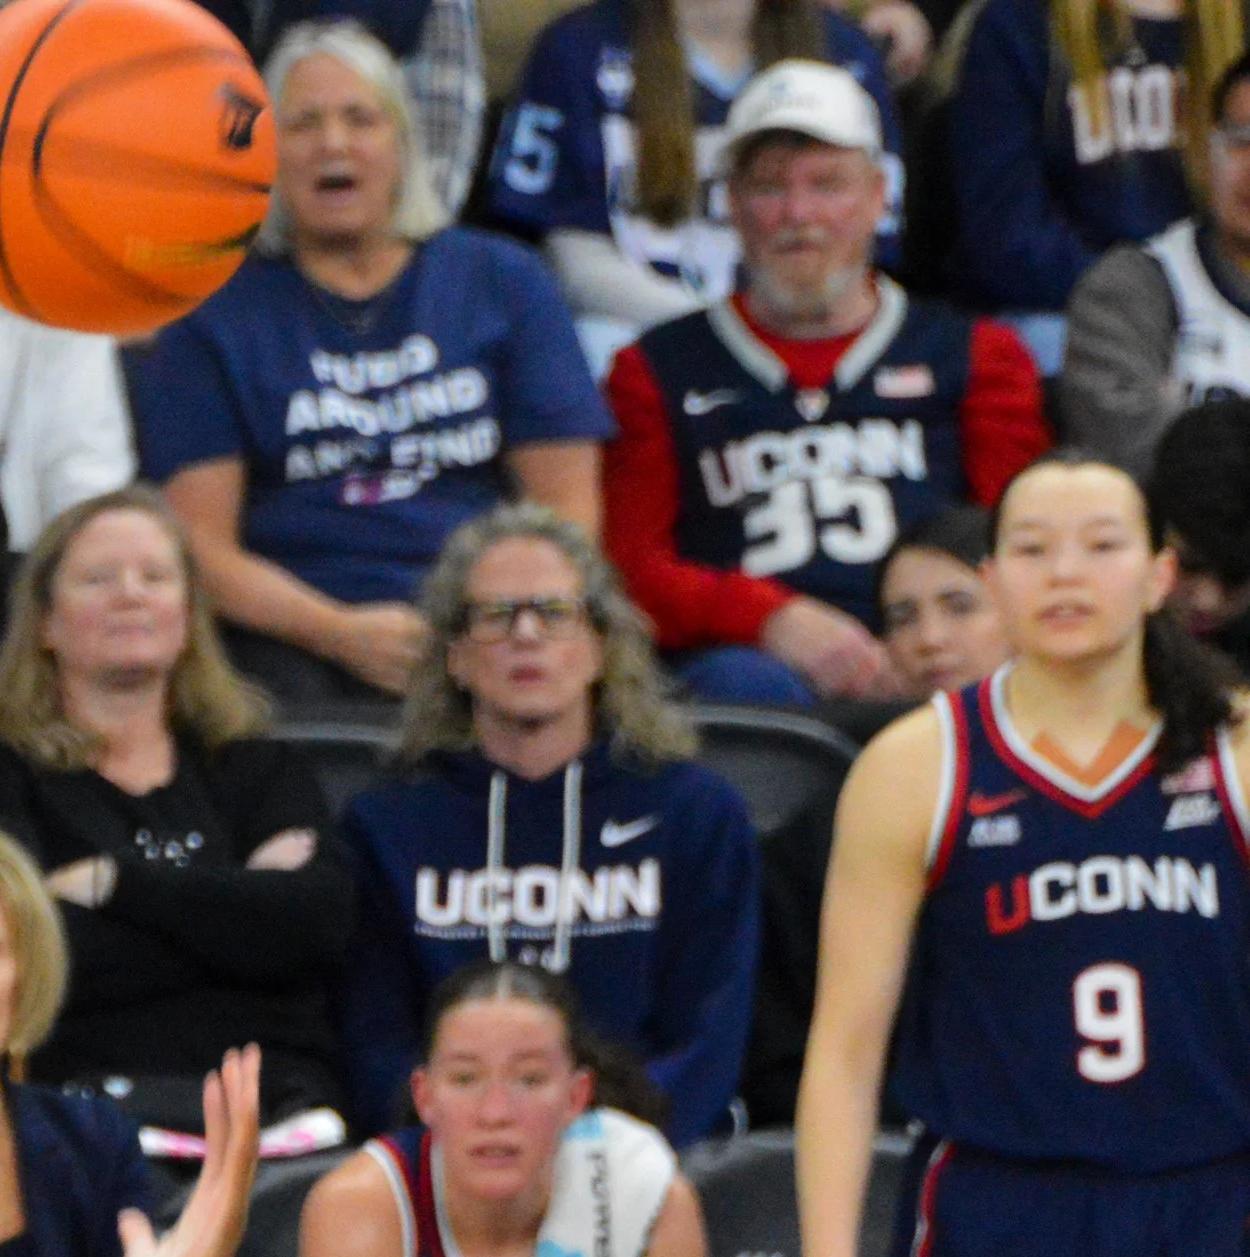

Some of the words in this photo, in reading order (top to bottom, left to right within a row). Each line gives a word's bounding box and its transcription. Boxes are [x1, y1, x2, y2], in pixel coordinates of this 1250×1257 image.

[698, 418, 928, 508] UCONN
[742, 474, 900, 578] 35
[414, 857, 662, 927] UCONN
[985, 855, 1220, 935] UCONN
[1073, 962, 1146, 1083] 9
